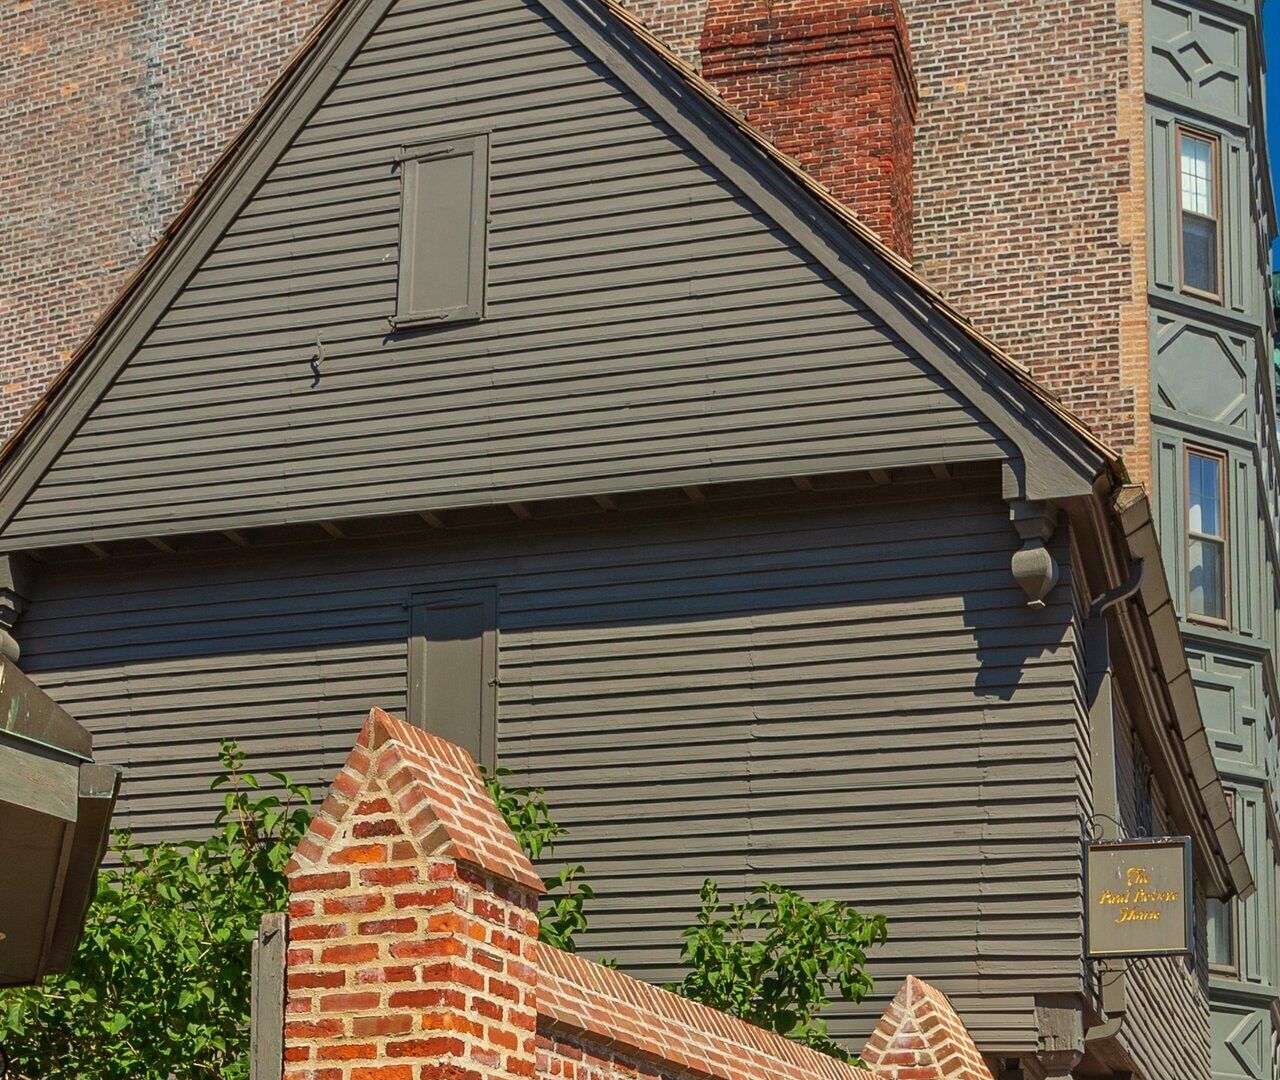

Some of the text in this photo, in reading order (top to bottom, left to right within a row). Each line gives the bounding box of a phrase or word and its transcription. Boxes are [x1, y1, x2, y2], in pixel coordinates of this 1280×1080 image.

[1127, 867, 1151, 886] The
[1099, 889, 1178, 904] Paul Revere
[1114, 907, 1160, 924] House
